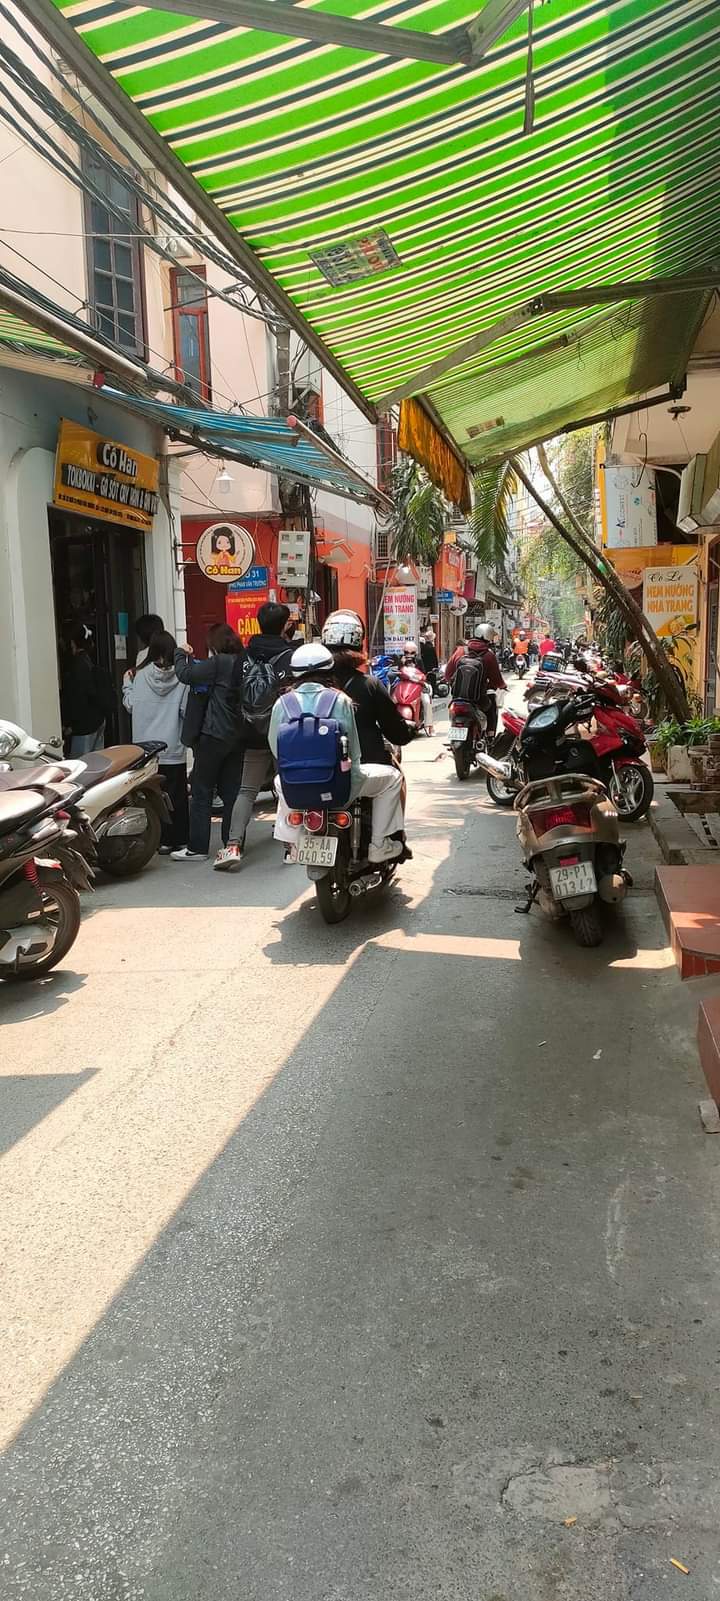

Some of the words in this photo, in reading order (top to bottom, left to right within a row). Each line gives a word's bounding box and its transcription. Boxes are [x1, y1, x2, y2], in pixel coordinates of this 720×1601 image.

[103, 443, 117, 468] Cô
[119, 450, 138, 477] Han
[206, 565, 219, 576] Cô
[220, 566, 242, 576] Han
[252, 570, 260, 578] 31
[647, 585, 664, 598] NEM
[395, 605, 414, 614] TRANG
[647, 600, 665, 613] NHA
[666, 599, 694, 613] TRANG
[303, 837, 331, 851] 35-AA
[298, 849, 333, 864] 040.59
[555, 863, 587, 883] 29-P1
